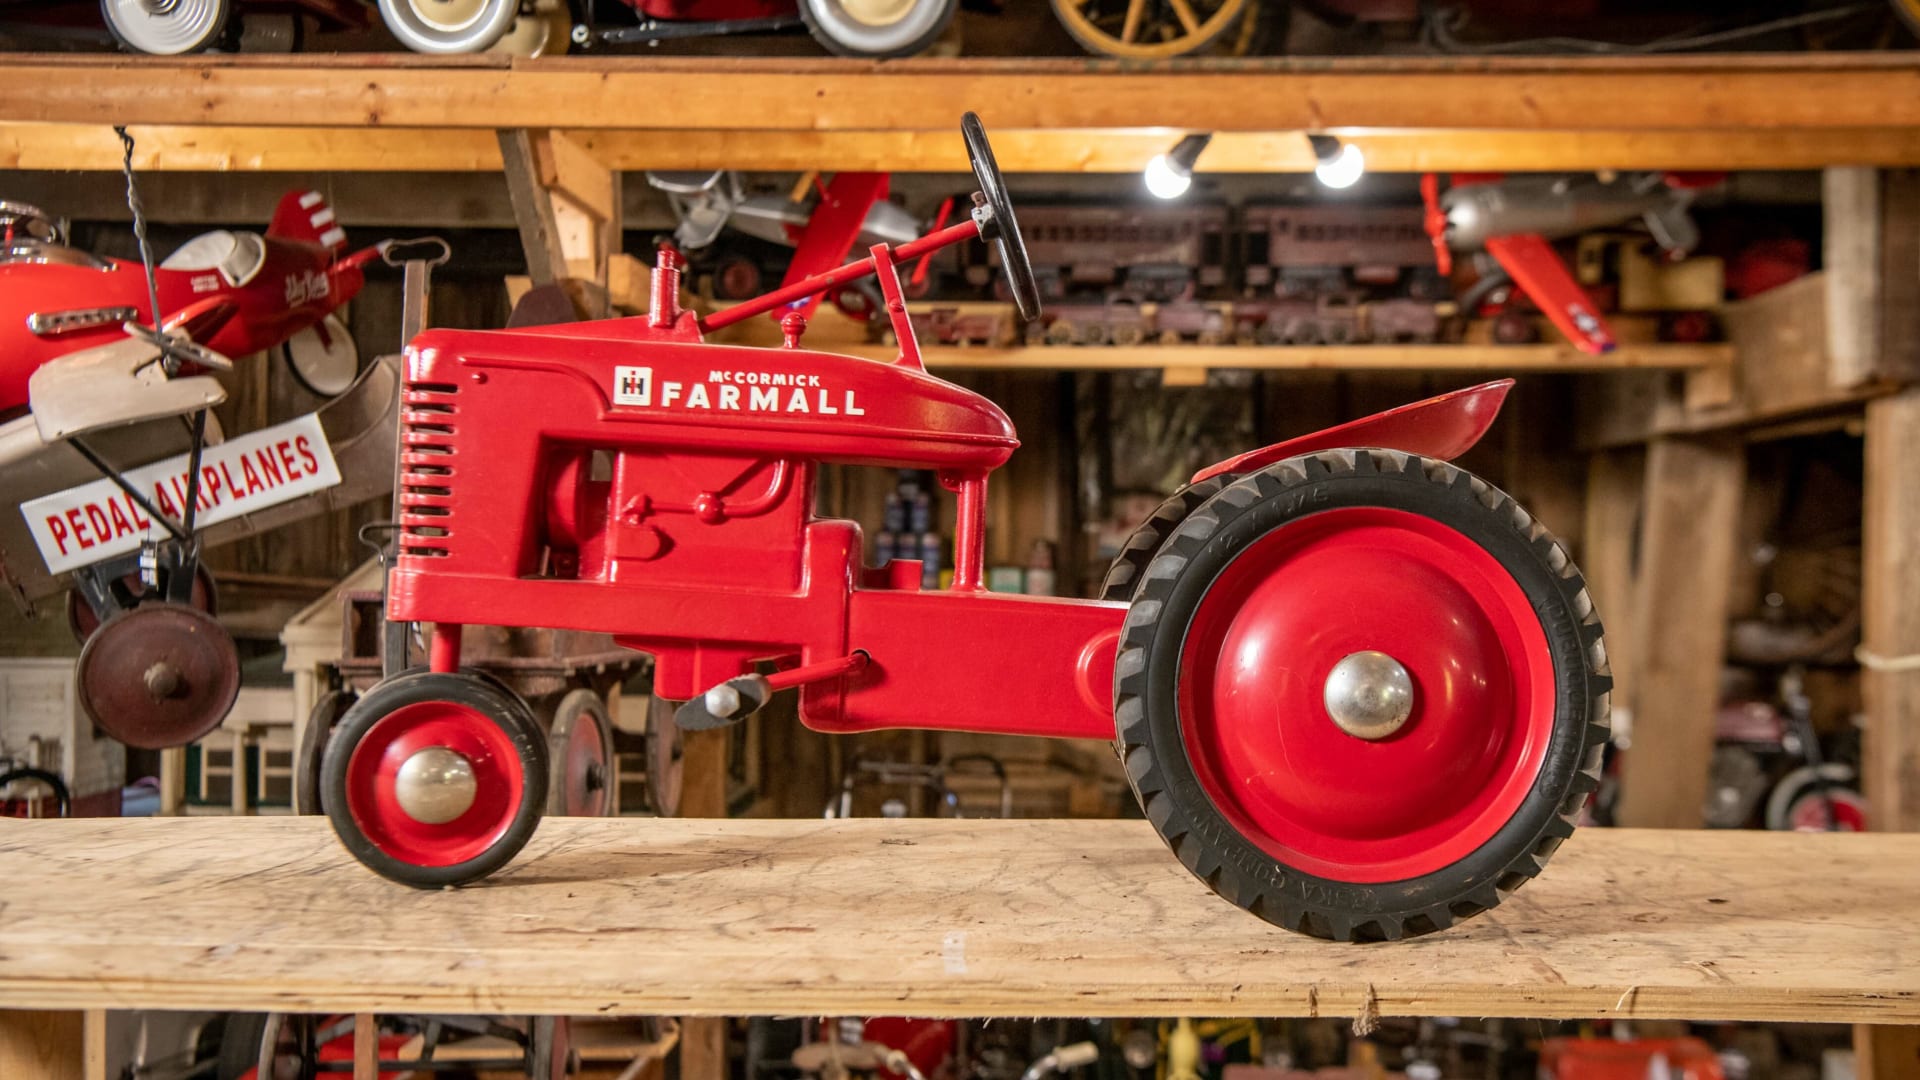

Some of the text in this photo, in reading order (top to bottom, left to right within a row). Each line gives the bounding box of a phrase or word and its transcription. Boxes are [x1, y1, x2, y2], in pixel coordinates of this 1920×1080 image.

[661, 381, 865, 416] FARMALL
[46, 434, 319, 556] PEDAL AIRPLANES
